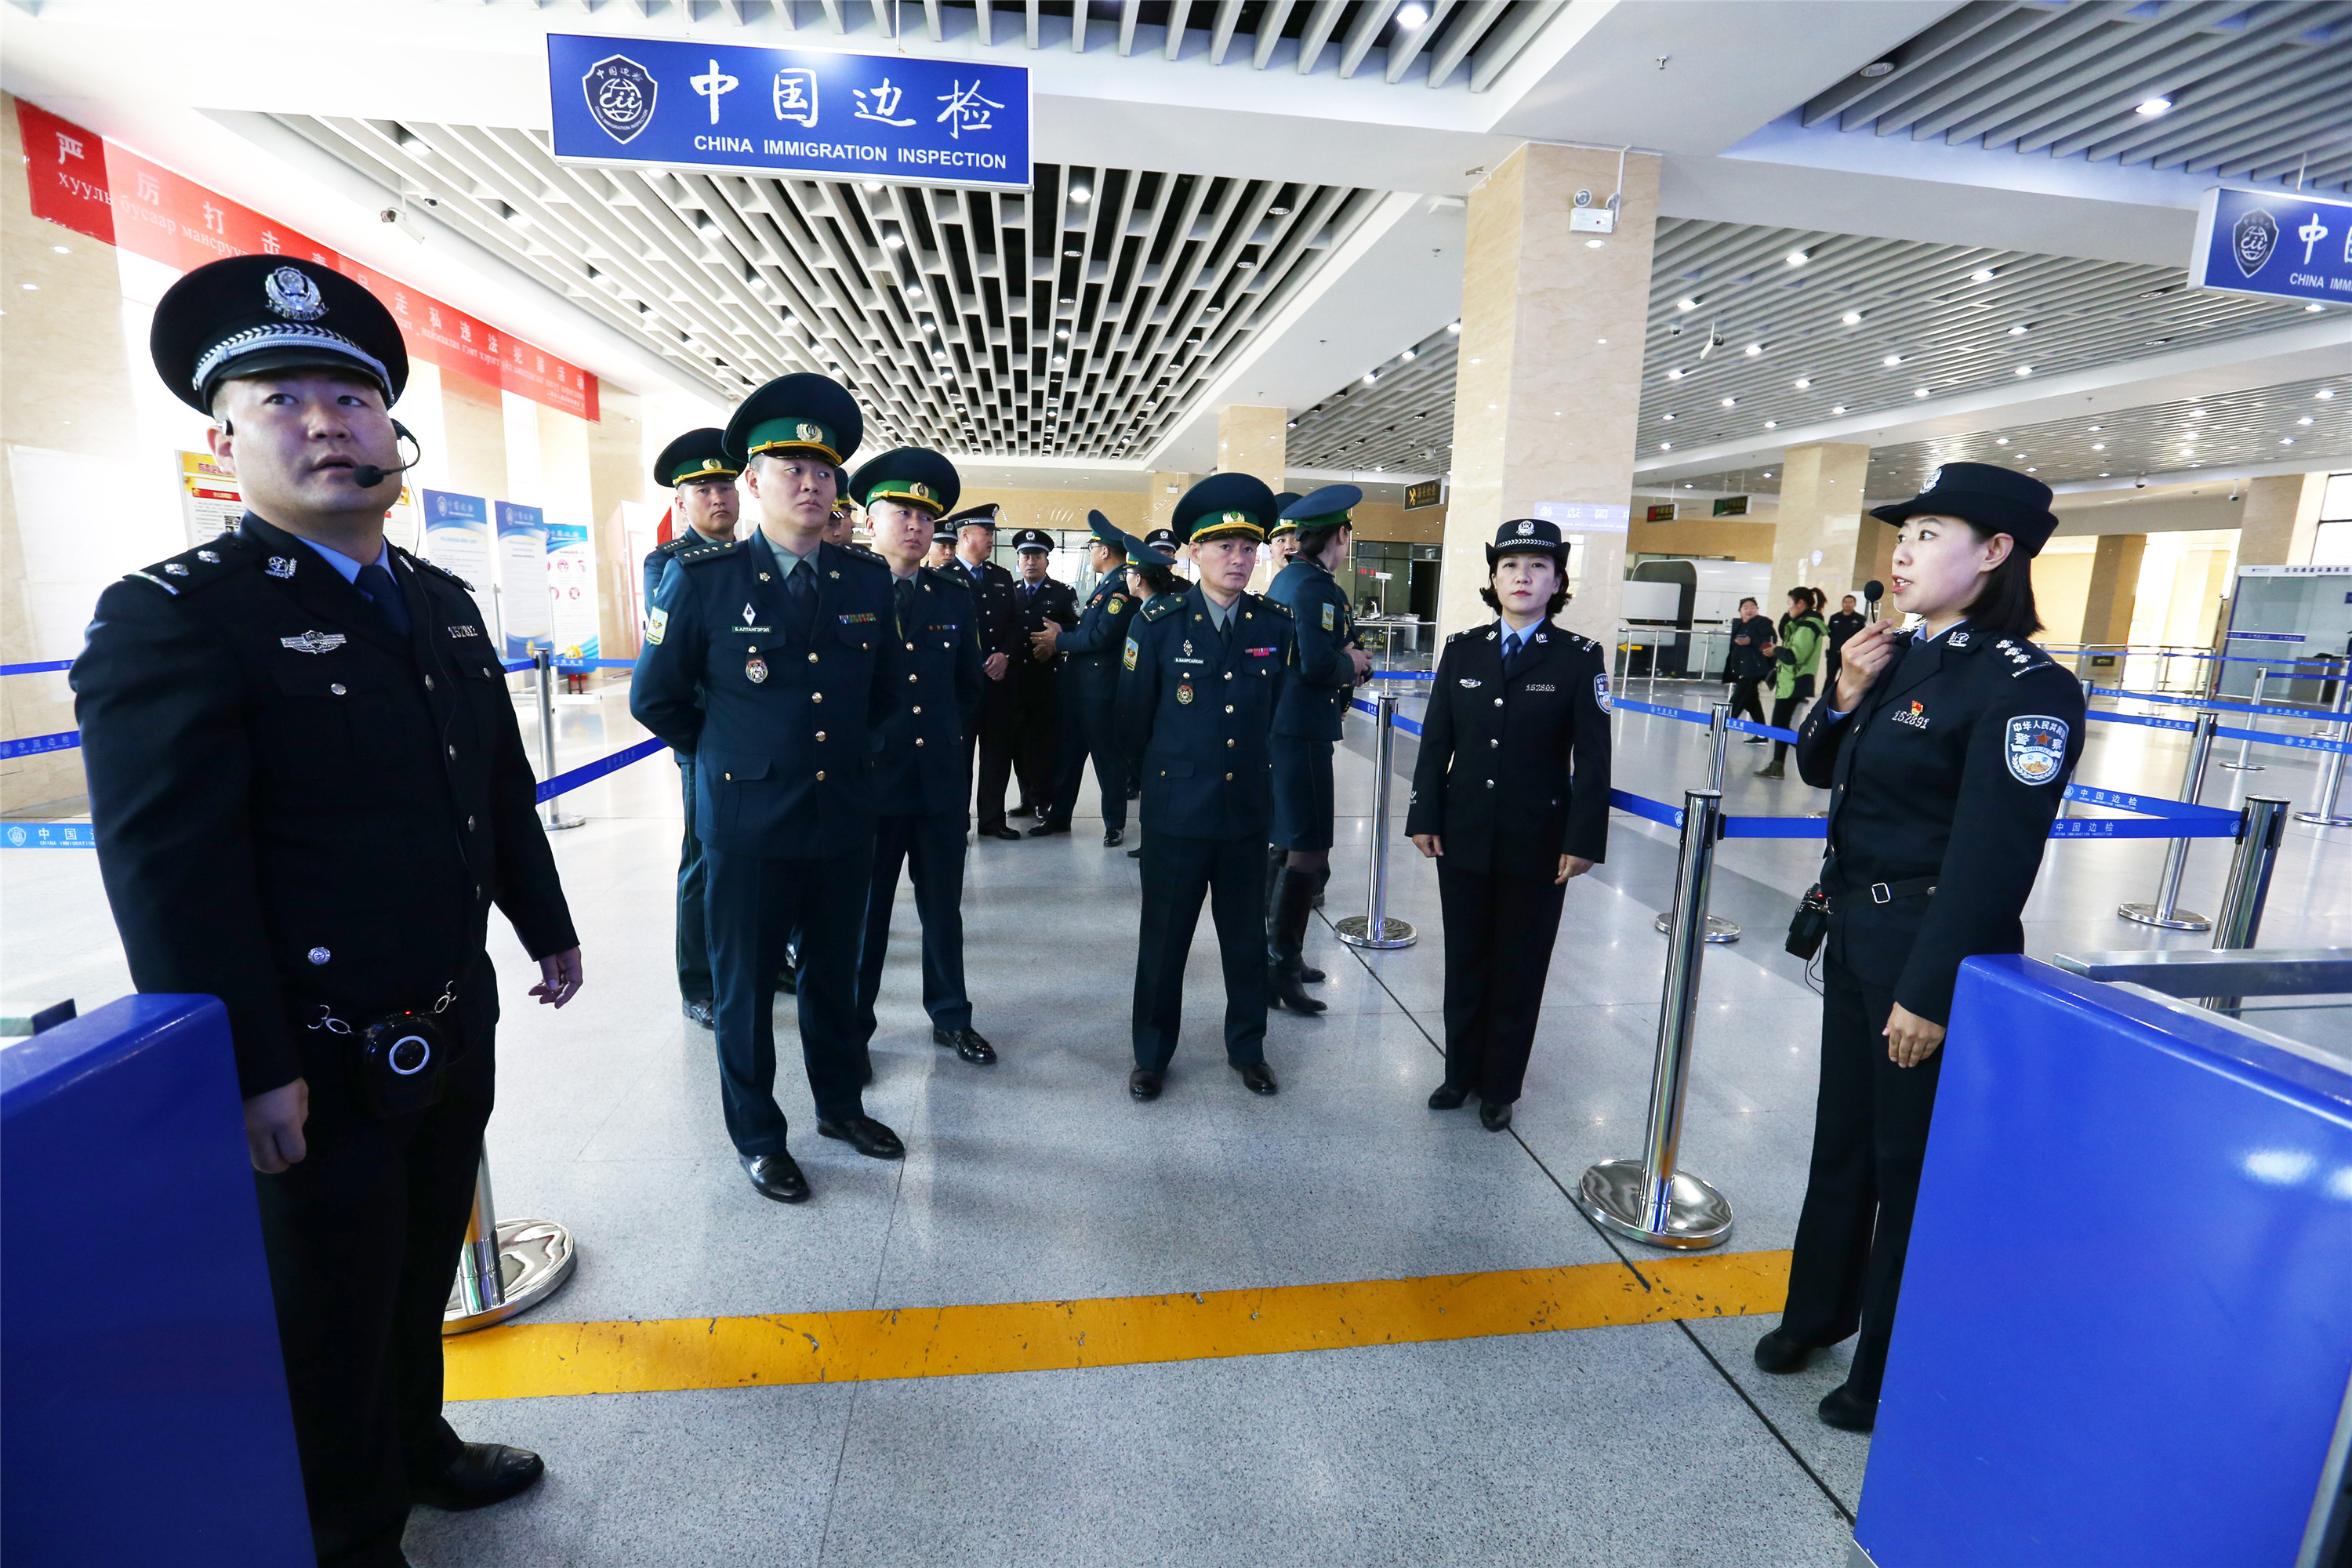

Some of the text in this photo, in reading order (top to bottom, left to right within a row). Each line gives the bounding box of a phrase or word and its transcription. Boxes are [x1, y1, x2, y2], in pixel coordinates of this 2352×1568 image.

[596, 66, 644, 82] 中国边检
[690, 59, 1005, 139] 中国边检
[694, 135, 1007, 169] CHINA IMMIGRATION INSPECTION
[2298, 212, 2352, 265] 中
[2289, 272, 2325, 289] CHINA
[1891, 710, 1930, 729] 152891
[2013, 720, 2067, 740] 中华人民共和国
[2080, 788, 2138, 807] 中国边检
[2056, 822, 2114, 833] 中国边检
